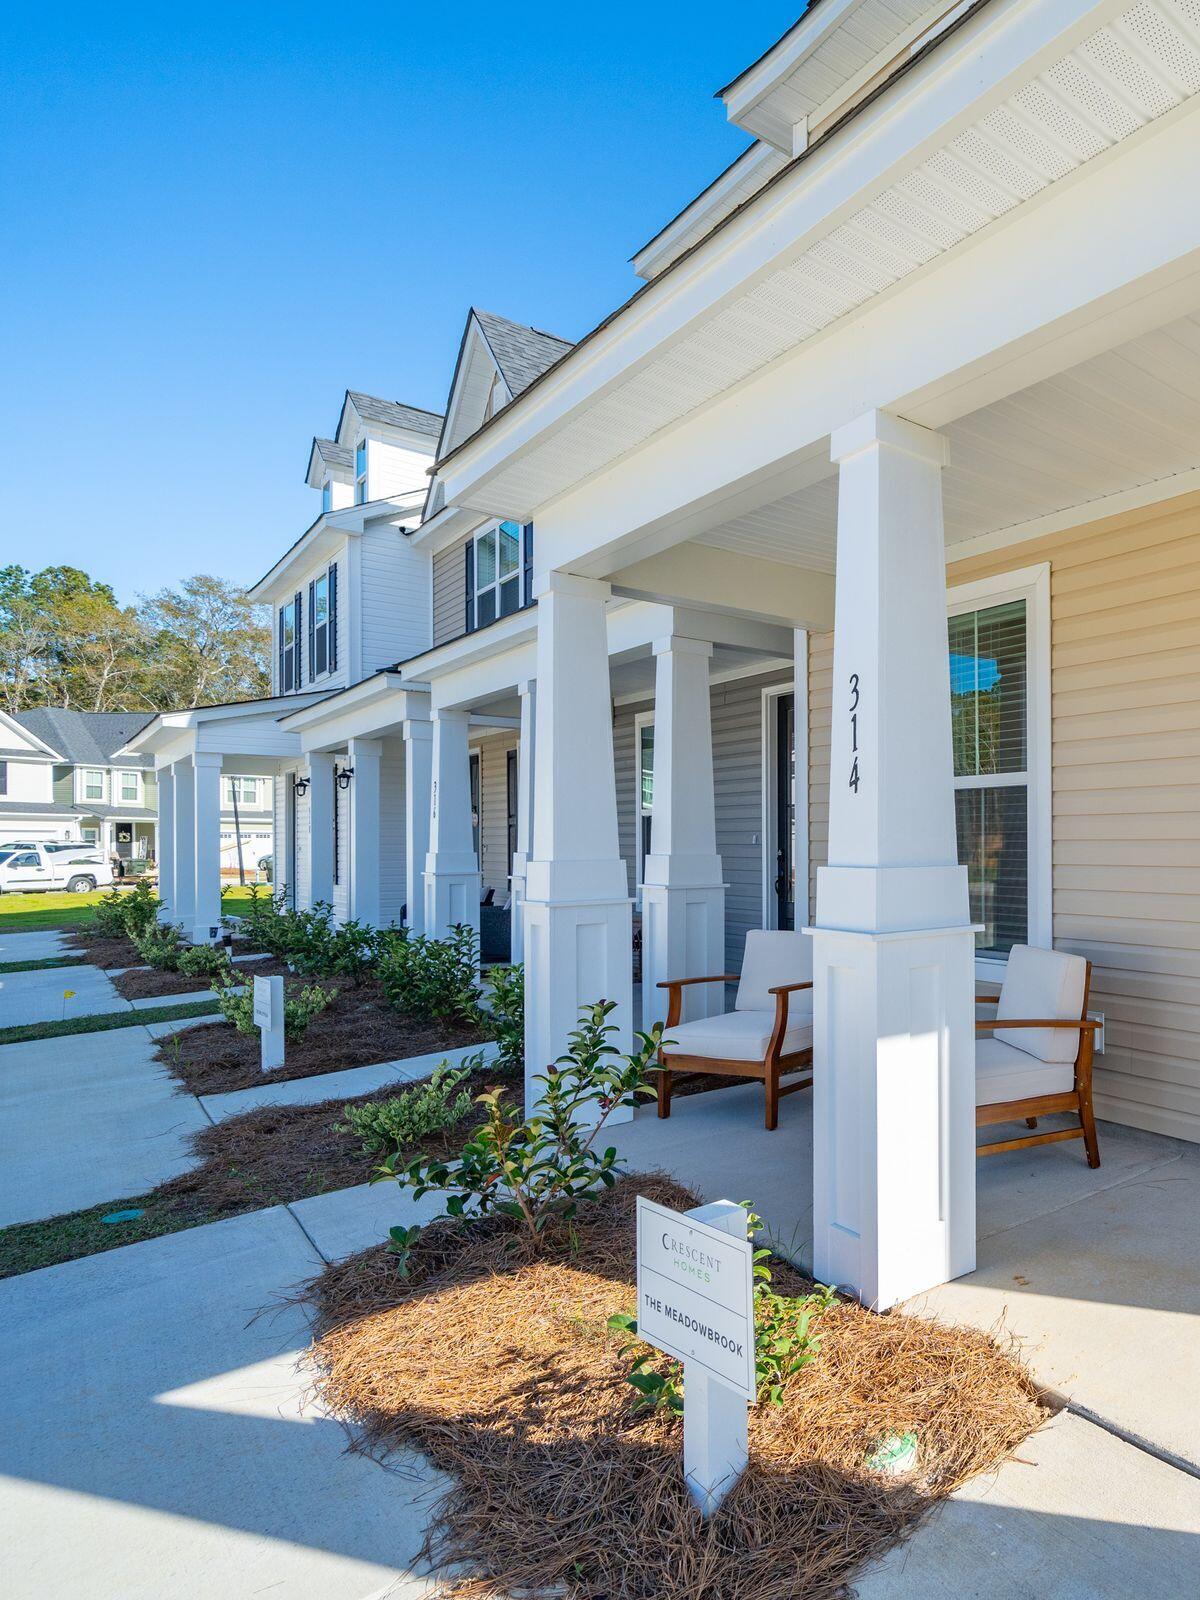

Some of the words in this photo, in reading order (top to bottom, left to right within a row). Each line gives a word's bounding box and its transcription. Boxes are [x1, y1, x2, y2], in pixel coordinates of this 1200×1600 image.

[849, 673, 860, 794] 314
[662, 1233, 722, 1273] CRESCENT
[673, 1258, 711, 1284] HOMES
[644, 1294, 662, 1313] THE
[664, 1304, 743, 1358] MEADOWBROOK
